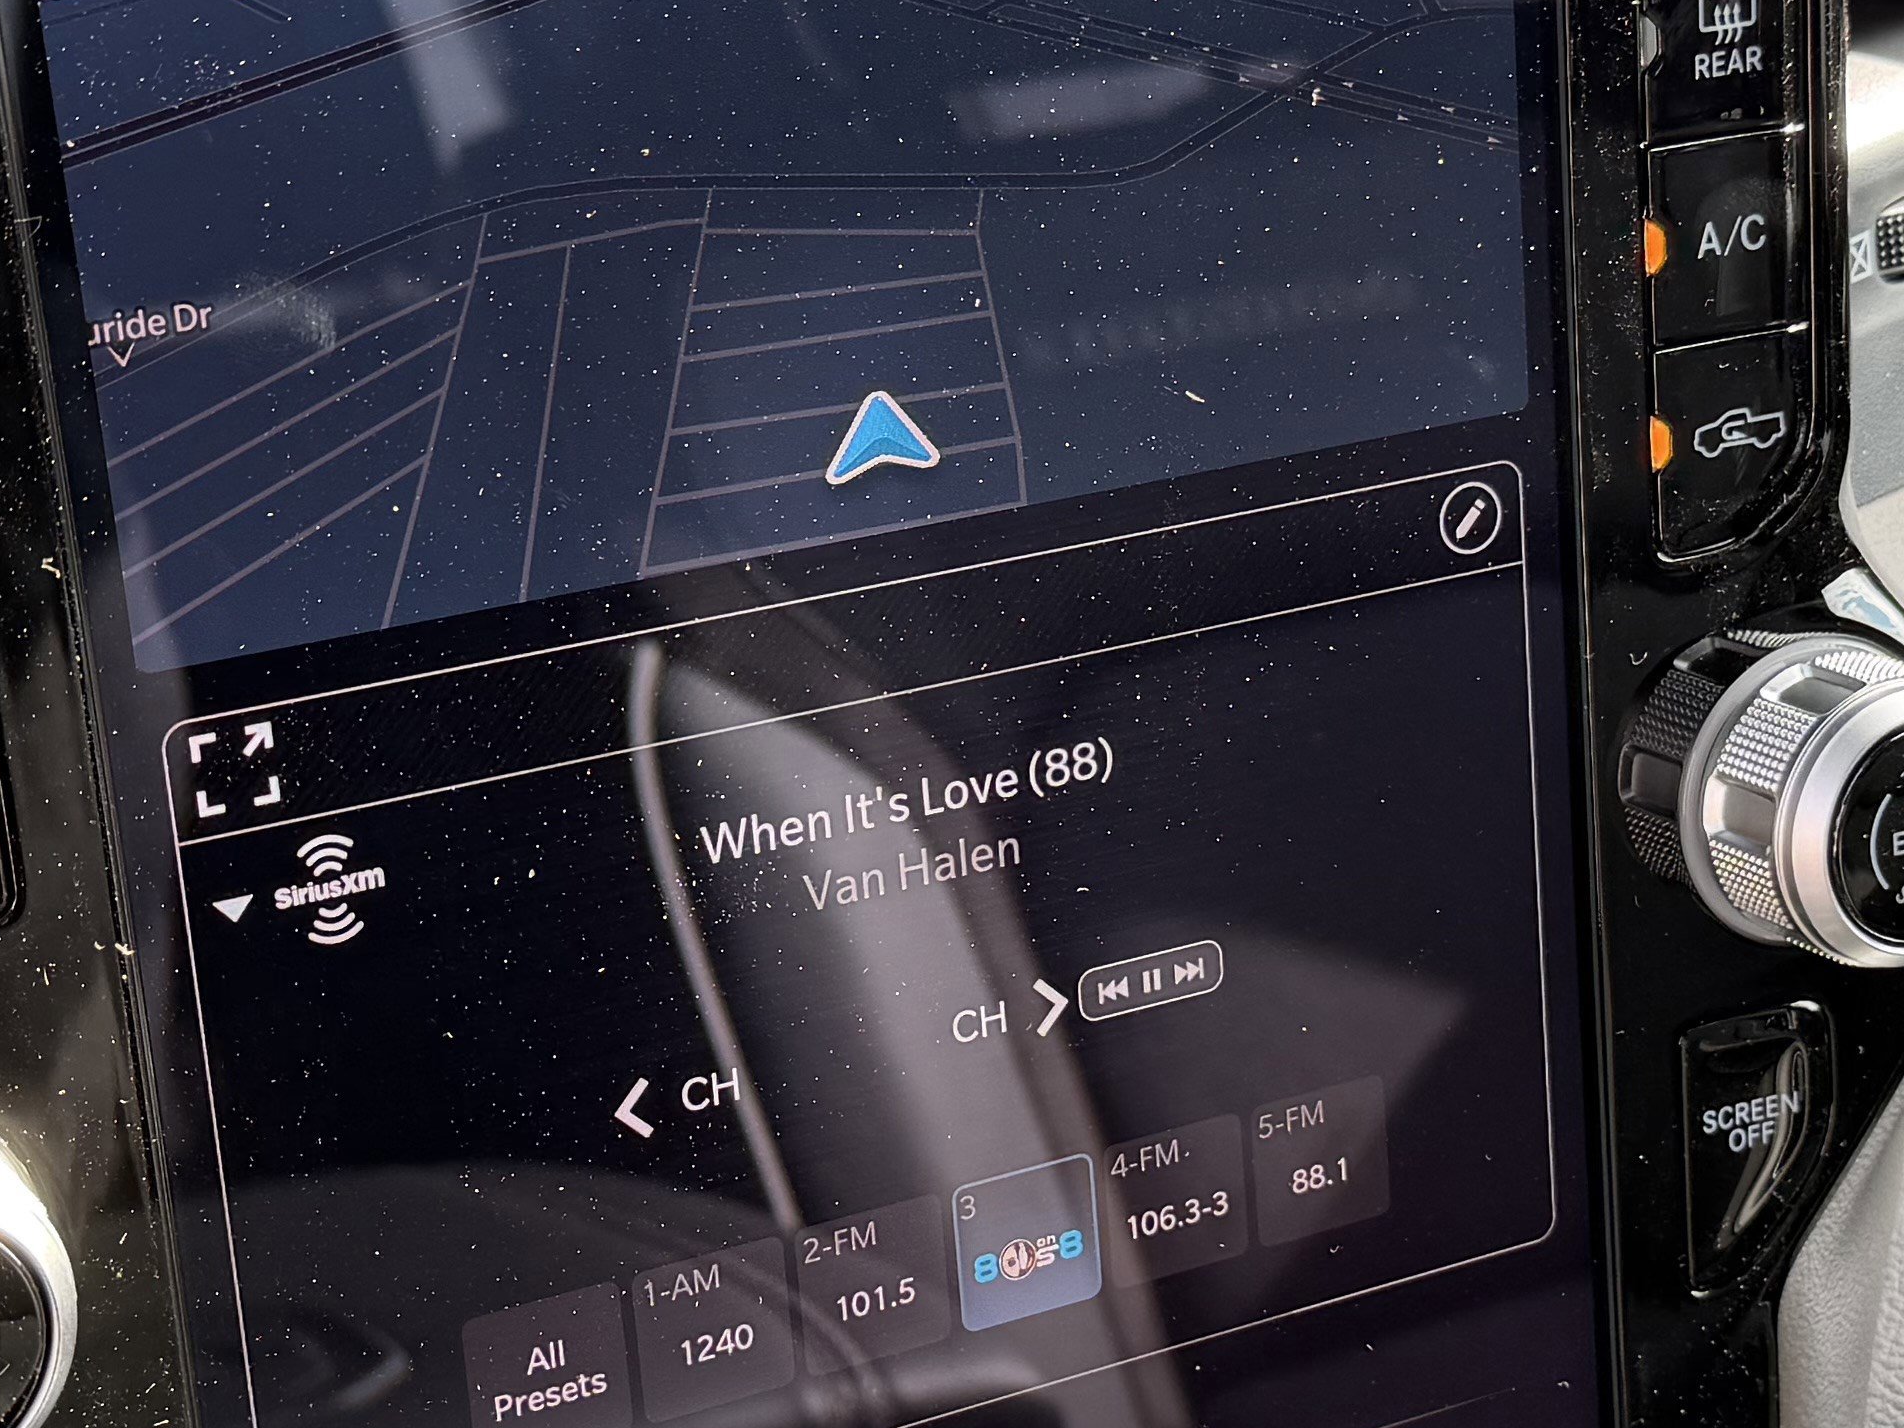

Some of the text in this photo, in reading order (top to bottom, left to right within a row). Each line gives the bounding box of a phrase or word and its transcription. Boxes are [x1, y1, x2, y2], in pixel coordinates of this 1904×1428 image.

[1695, 47, 1763, 78] REAR
[1697, 213, 1766, 258] A/C
[174, 304, 212, 332] Dr
[700, 736, 1113, 864] When It's Love (88)
[803, 837, 1020, 910] Van Halen
[952, 1001, 1006, 1043] CH
[682, 1068, 741, 1111] CH
[1259, 1100, 1324, 1138] 5-FM
[1703, 1091, 1798, 1134] SCREEN
[1111, 1139, 1179, 1177] 4-FM
[1729, 1122, 1774, 1153] OFF
[1292, 1157, 1347, 1193] 88.1
[959, 1195, 976, 1220] 3
[1128, 1191, 1228, 1239] 106.3-3
[803, 1221, 878, 1264] 2-FM
[644, 1264, 721, 1306] 1-AM
[836, 1278, 916, 1322] 101.5
[526, 1340, 565, 1376] All
[680, 1324, 754, 1366] 1240
[494, 1370, 607, 1422] Presets
